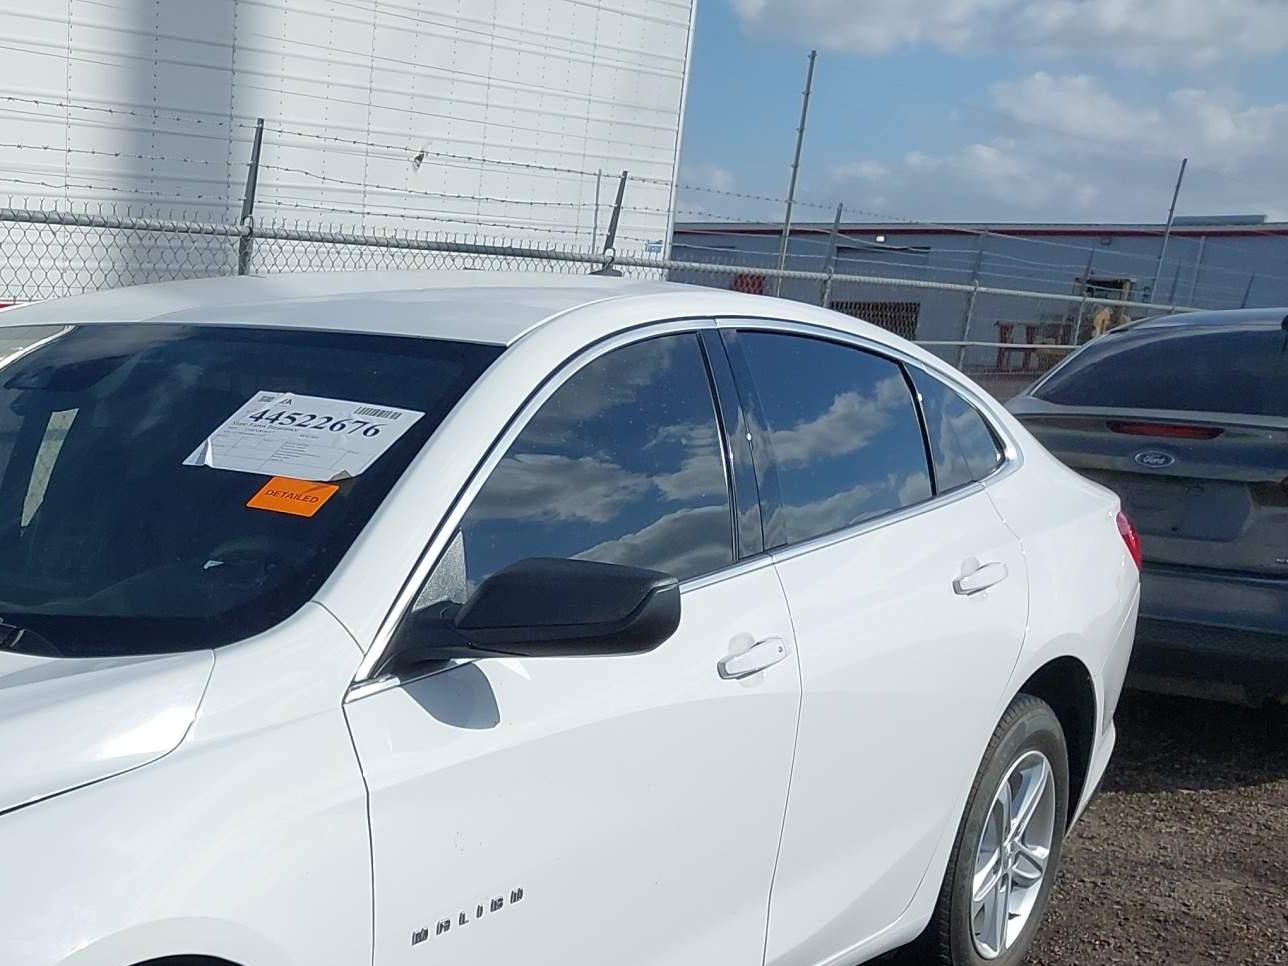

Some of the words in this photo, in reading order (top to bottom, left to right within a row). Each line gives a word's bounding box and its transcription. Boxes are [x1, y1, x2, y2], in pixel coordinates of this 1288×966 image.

[248, 409, 387, 438] 44522676
[264, 489, 320, 504] DETAILED
[411, 887, 524, 946] MALIBU
